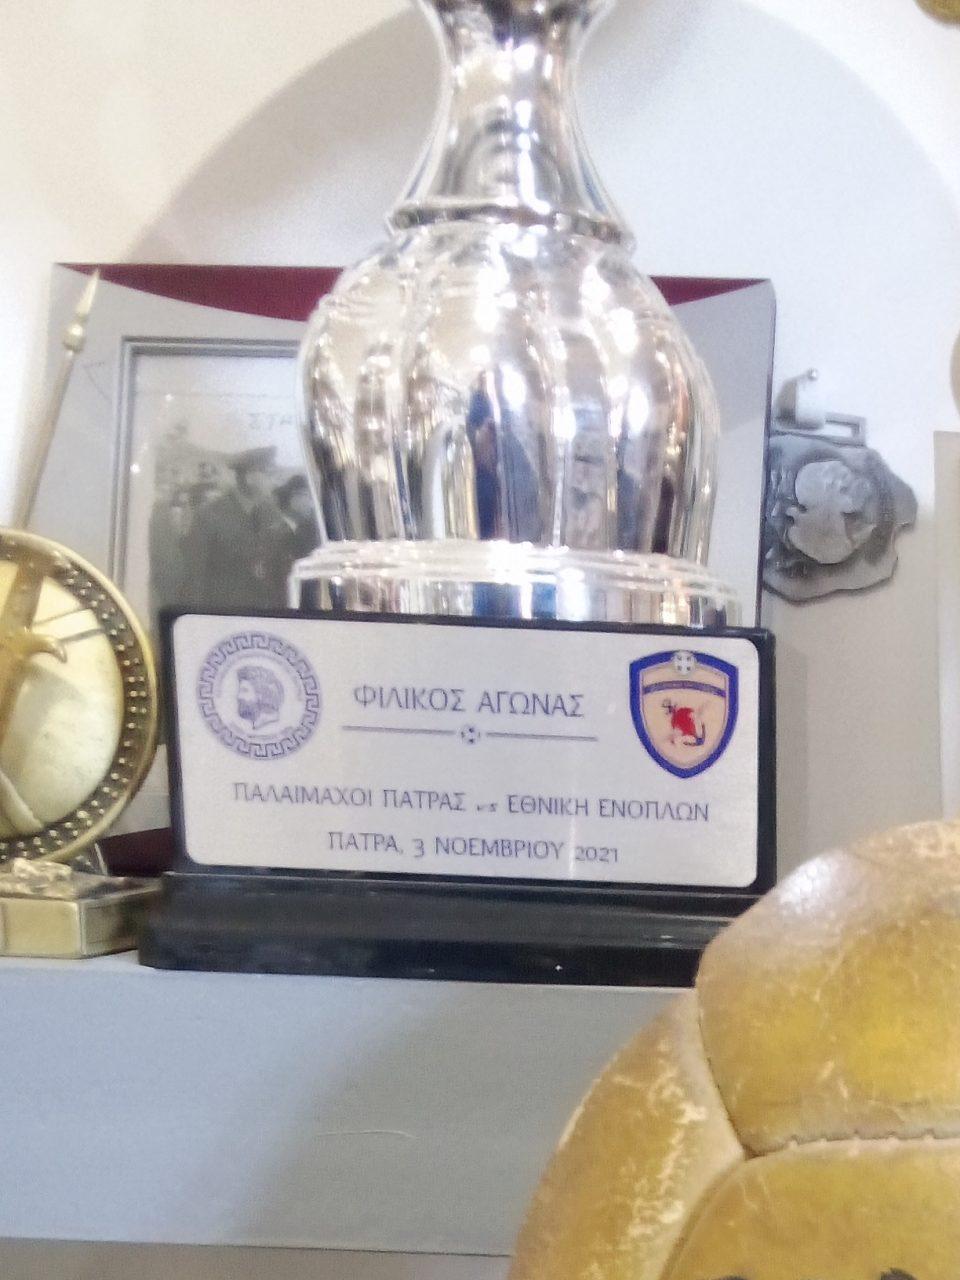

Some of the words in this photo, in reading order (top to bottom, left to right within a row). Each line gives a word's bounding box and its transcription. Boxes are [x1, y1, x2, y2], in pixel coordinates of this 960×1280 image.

[353, 685, 466, 712] ΦΙΛΙΚΟΣ
[478, 690, 584, 718] ΑΓΩΝΑΣ
[232, 782, 373, 807] ΠΑΛΑΙΜΑΧΟΙ
[383, 789, 467, 812] ΠΑΤΡΑΣ
[507, 794, 589, 817] ΕΘΝΙΚΗ
[599, 798, 710, 822] ΕΝΟΠΛΩΝ
[412, 838, 425, 858] 3
[434, 836, 564, 860] ΝΟΕΜΒΡΙΟΥ
[575, 845, 619, 863] 2021
